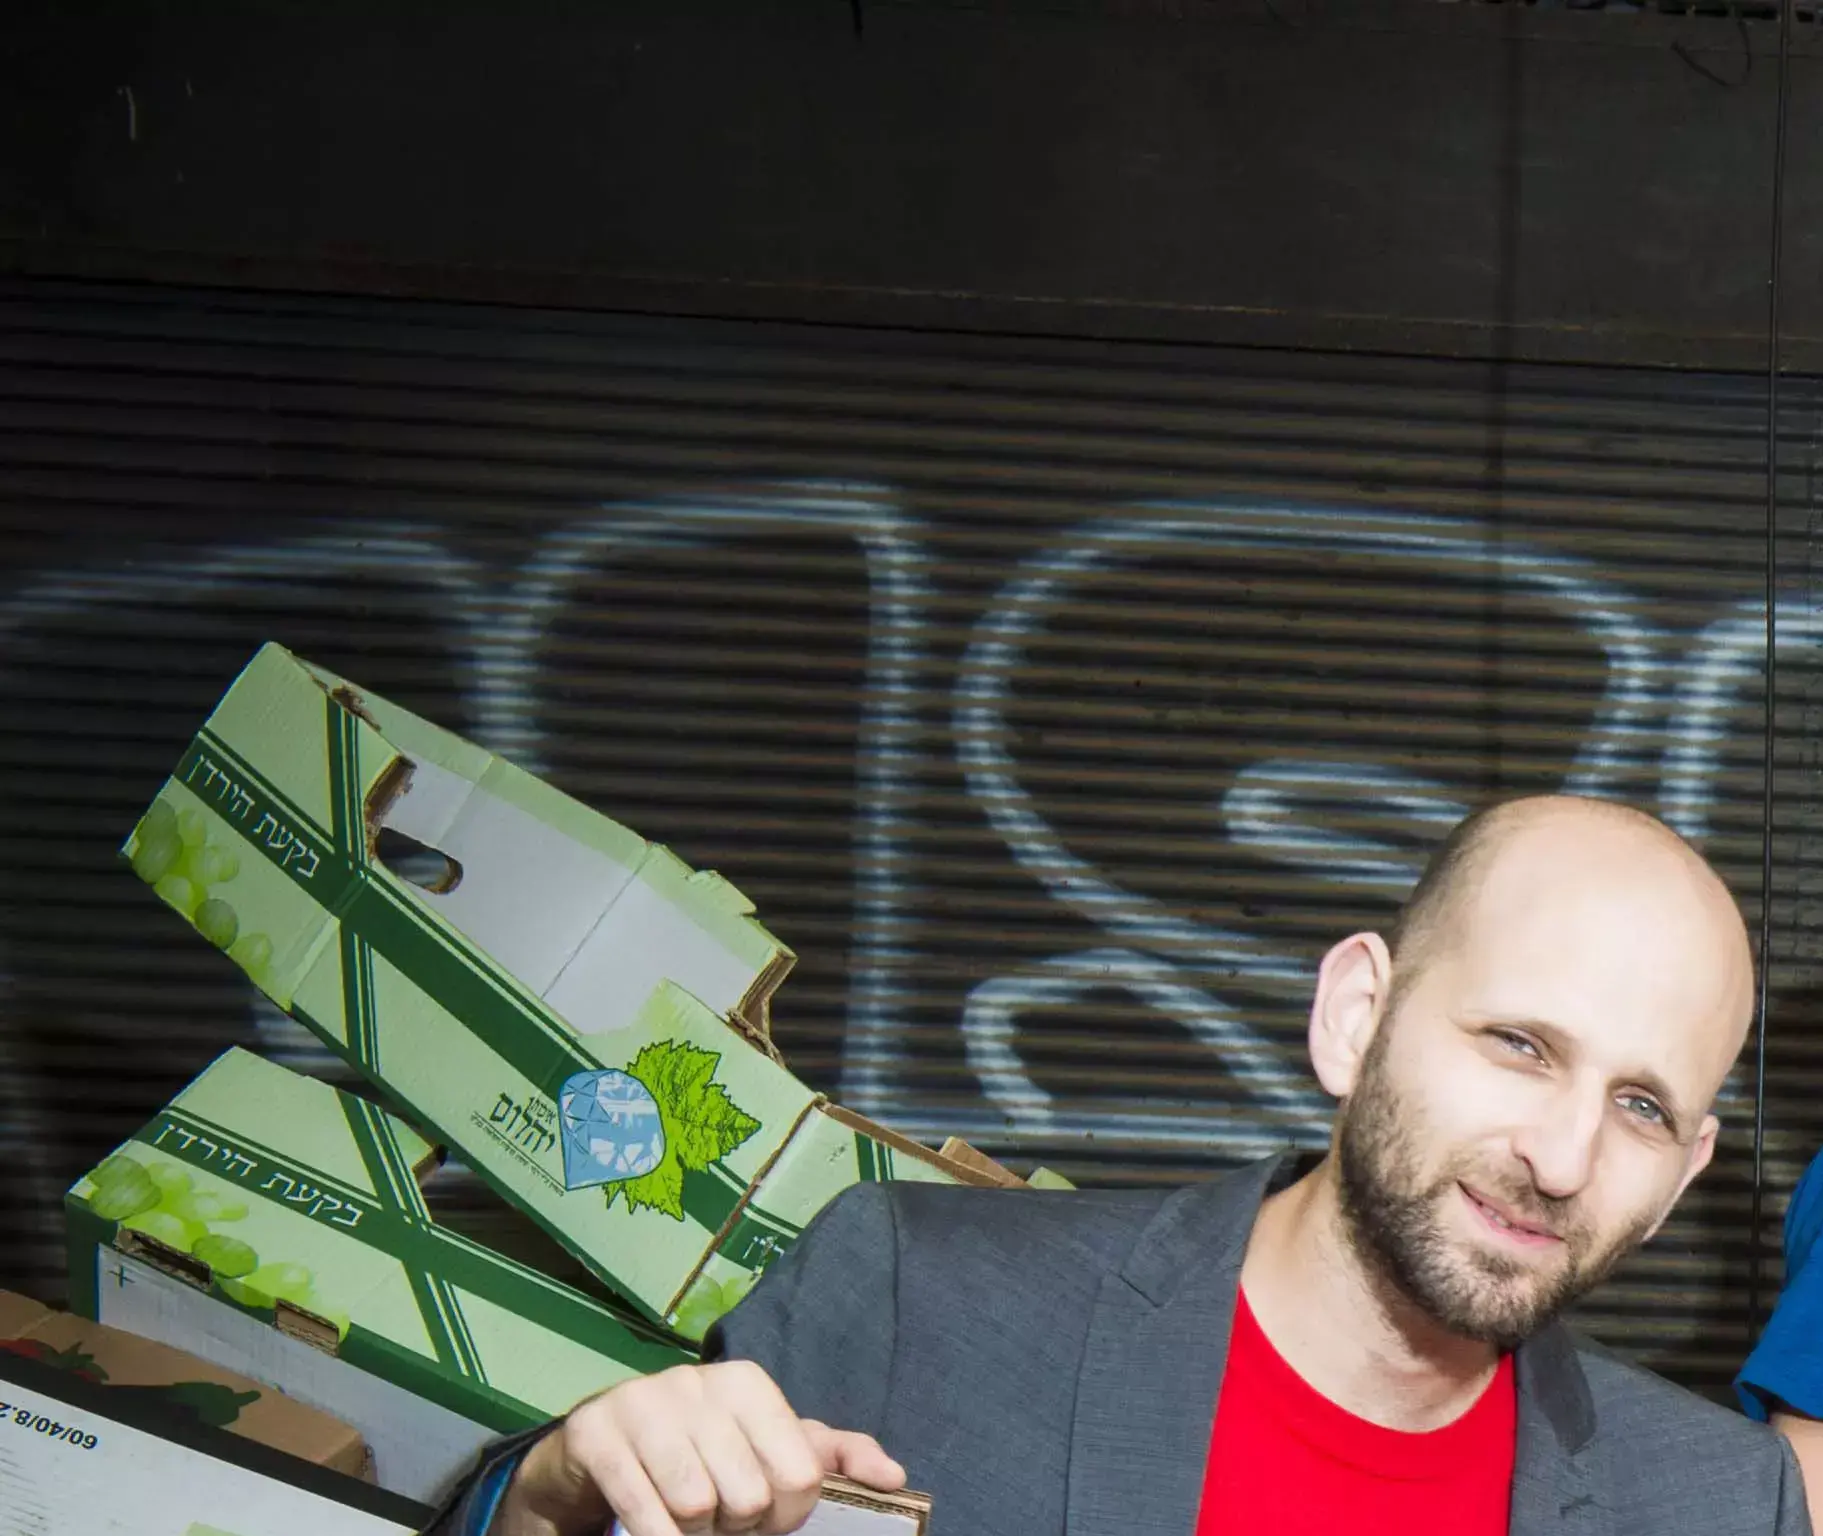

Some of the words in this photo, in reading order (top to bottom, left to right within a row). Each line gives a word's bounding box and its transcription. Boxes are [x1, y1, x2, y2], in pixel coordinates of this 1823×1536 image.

[187, 754, 255, 820] הירדן
[253, 812, 320, 878] בקעת
[154, 1124, 257, 1176] הירדן
[490, 1092, 555, 1153] יהלום
[261, 1172, 363, 1227] בקעת
